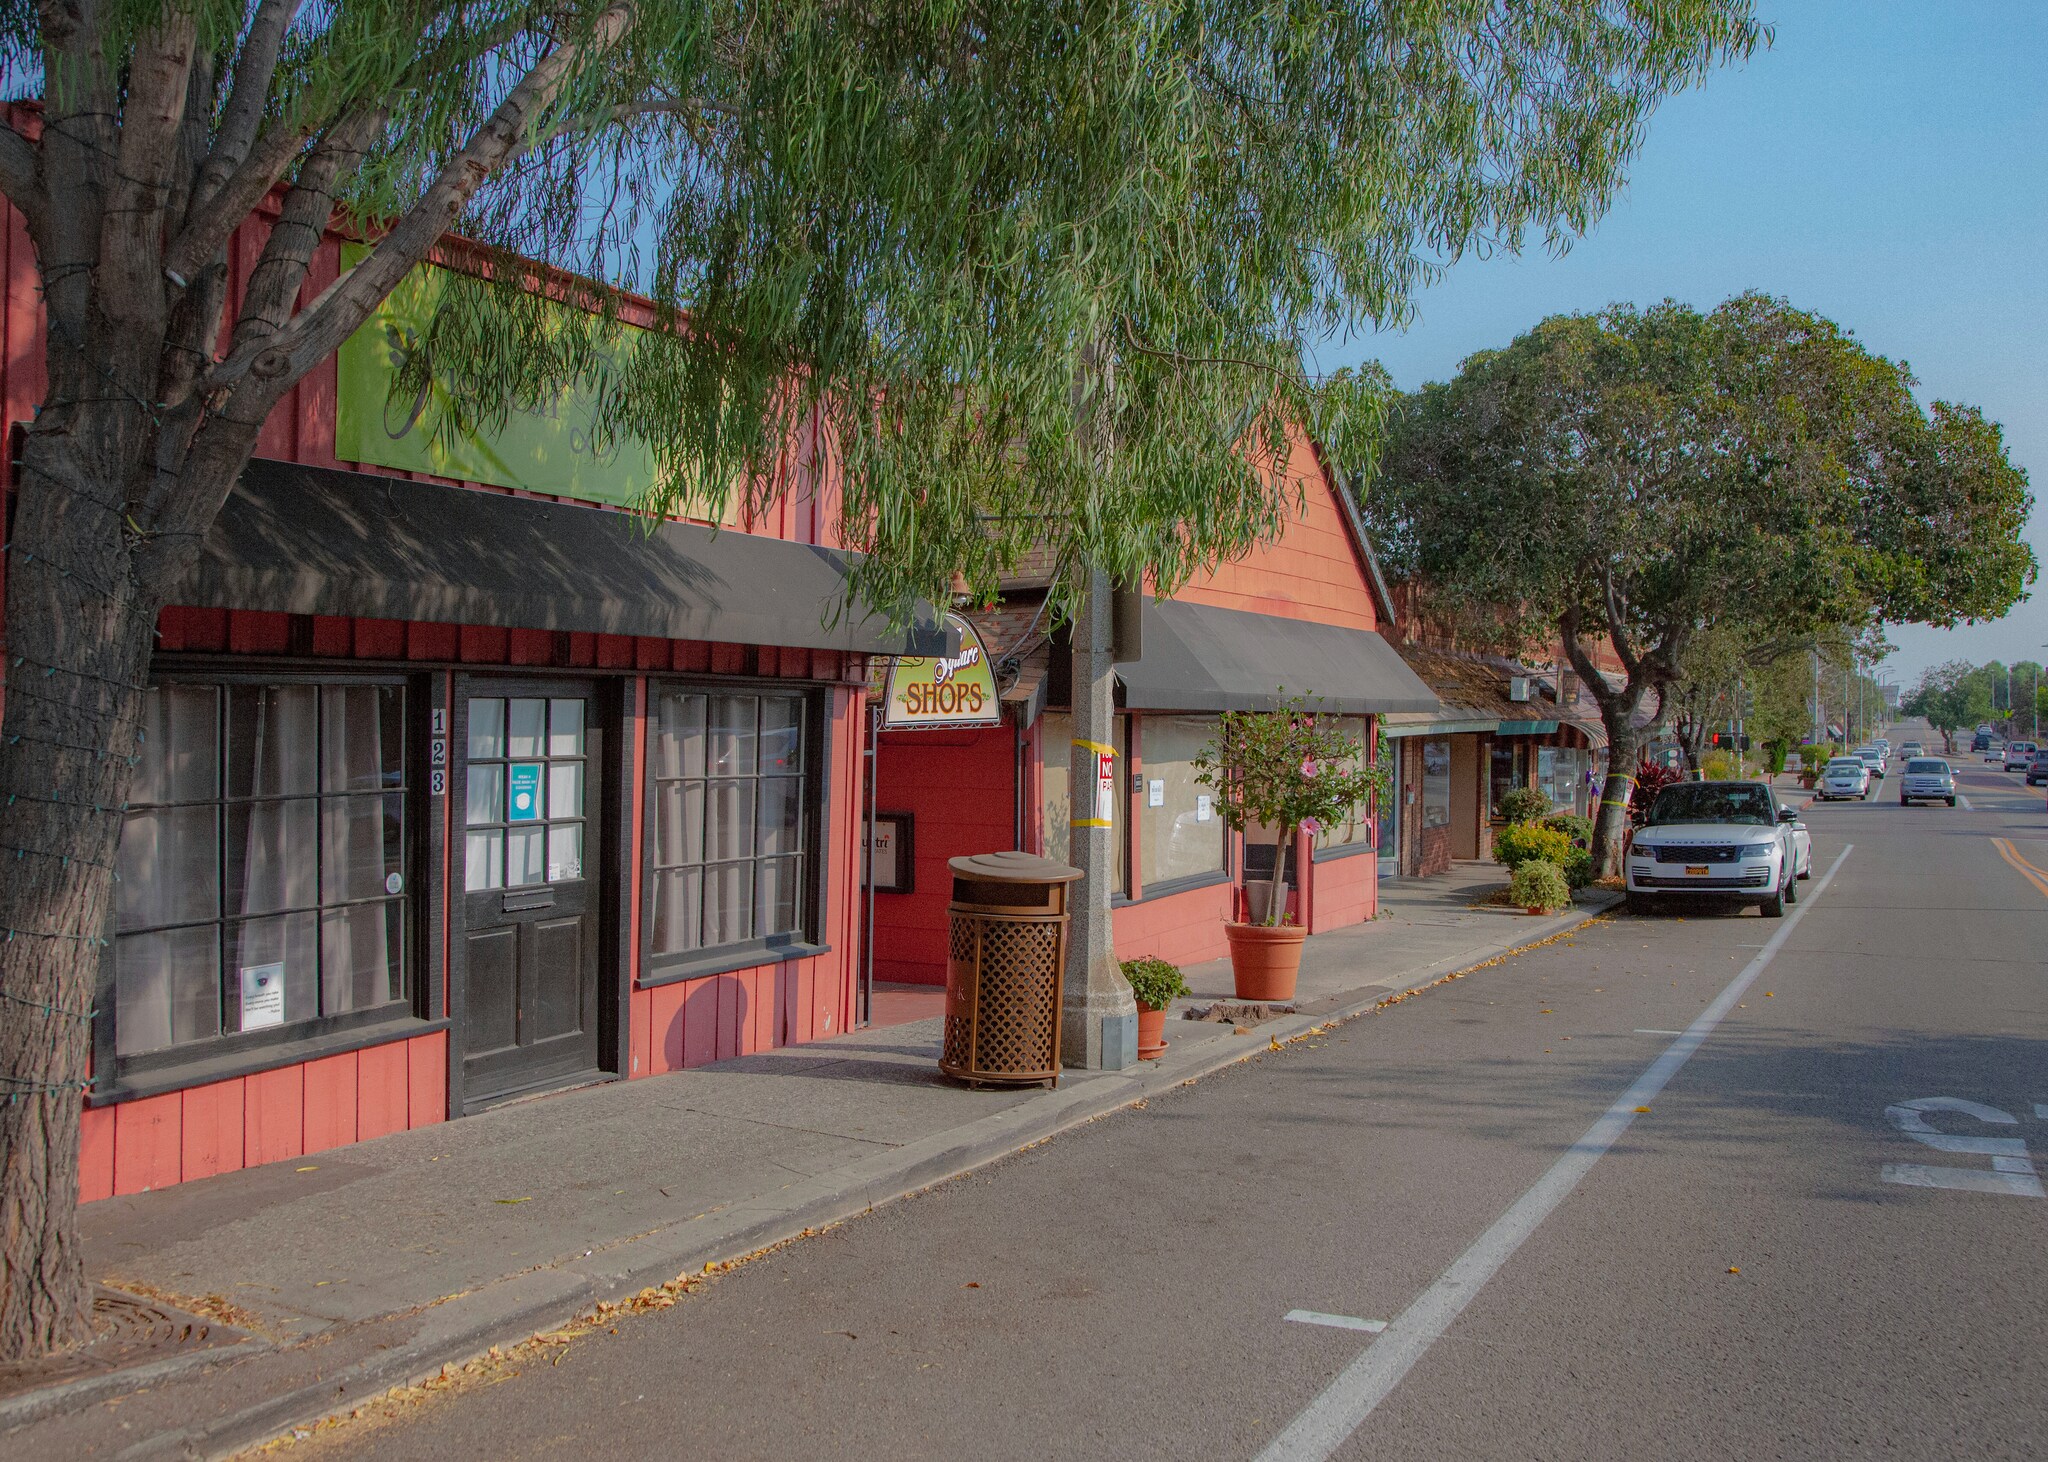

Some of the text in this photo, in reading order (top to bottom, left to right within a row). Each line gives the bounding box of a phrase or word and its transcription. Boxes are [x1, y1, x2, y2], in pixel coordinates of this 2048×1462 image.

[906, 682, 982, 715] SHOPS
[433, 711, 445, 793] 123
[1102, 761, 1113, 777] NO
